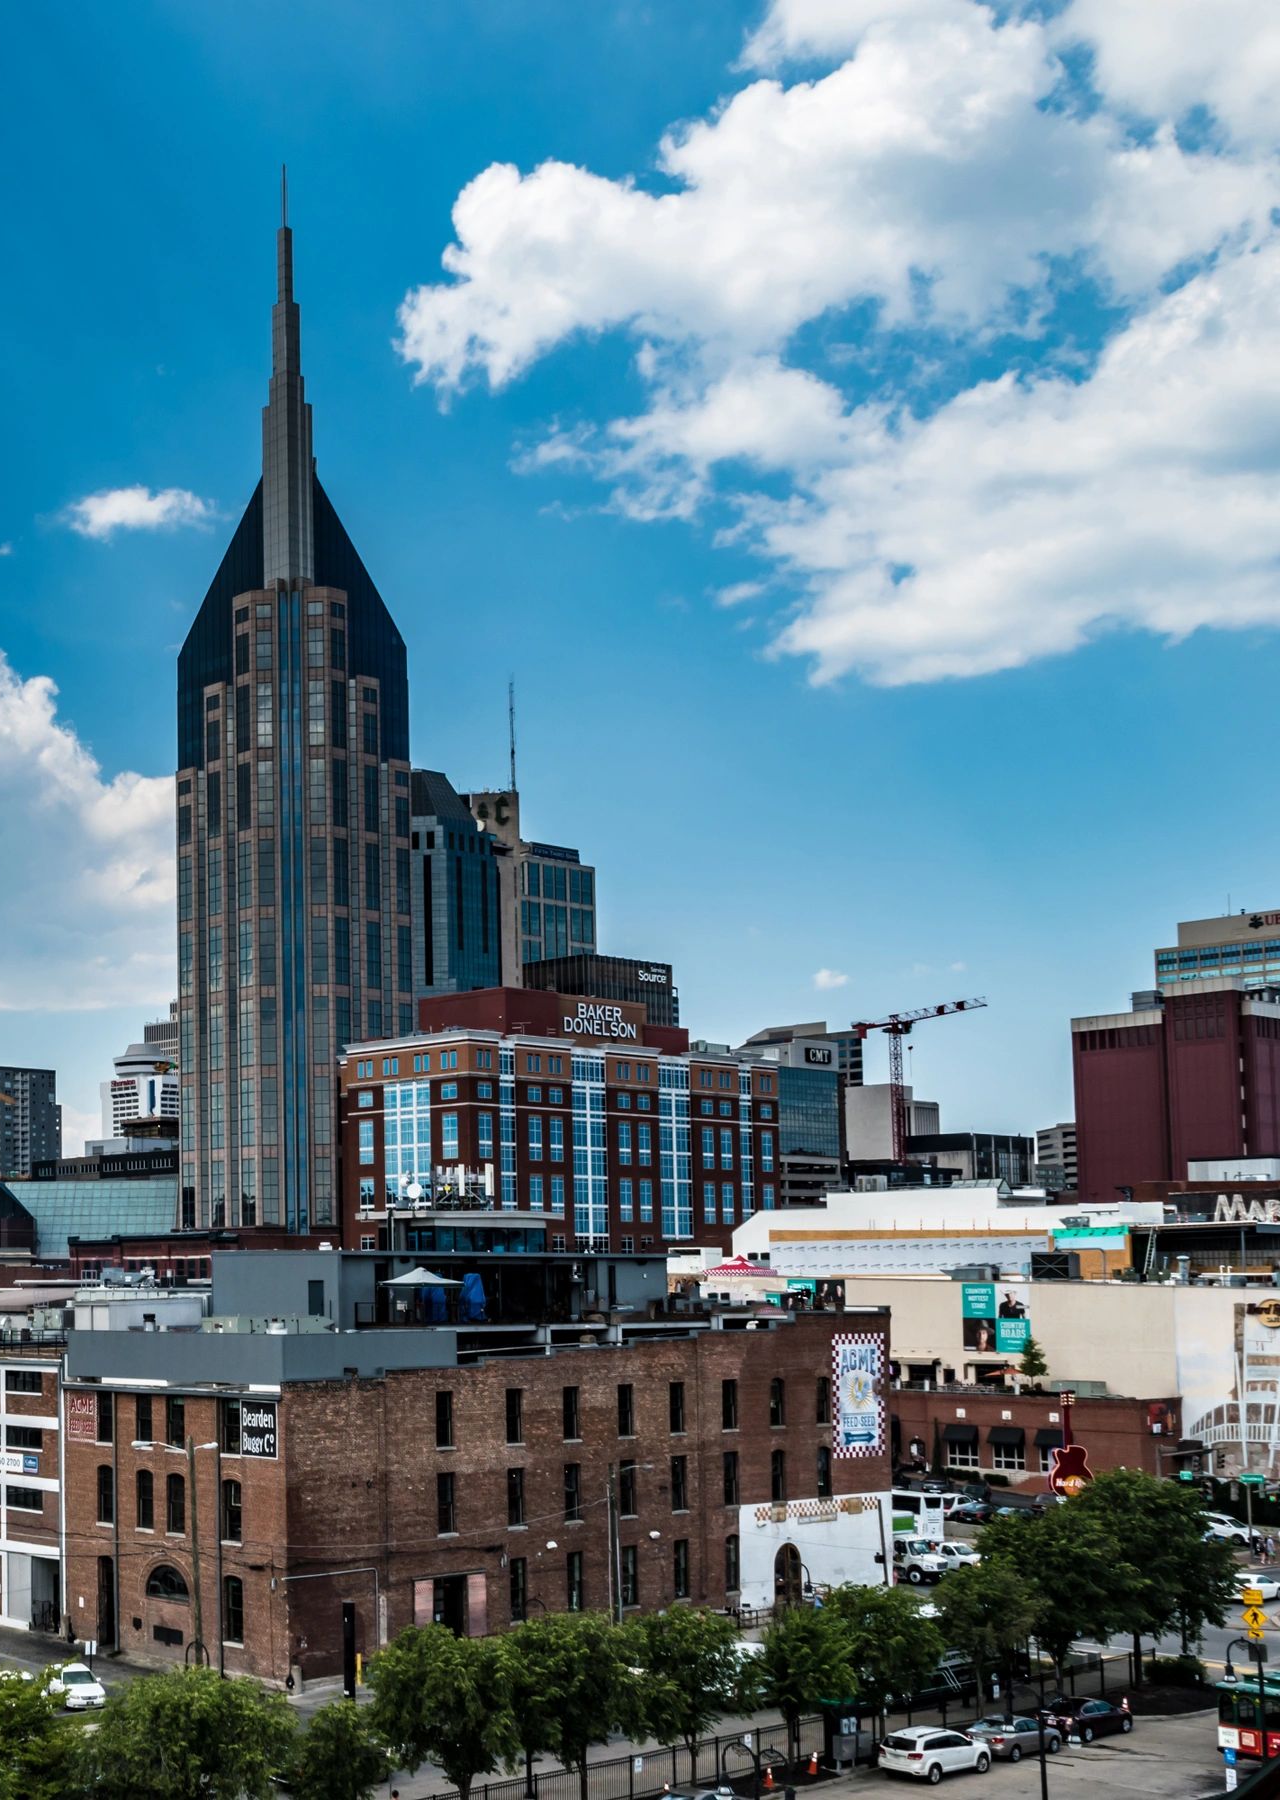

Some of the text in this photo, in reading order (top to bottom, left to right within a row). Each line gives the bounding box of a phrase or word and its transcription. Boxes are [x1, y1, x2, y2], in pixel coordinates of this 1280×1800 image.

[638, 970, 667, 984] Source
[577, 1002, 622, 1022] BAKER
[563, 1016, 637, 1039] DONELSON
[809, 1049, 829, 1063] CMT
[1000, 1329, 1026, 1339] ROADS
[840, 1348, 877, 1376] ACME
[70, 1397, 94, 1415] ACME
[242, 1407, 274, 1429] Bearden
[843, 1416, 858, 1428] FEED
[242, 1431, 263, 1454] Buggy
[6, 1457, 21, 1468] 2700
